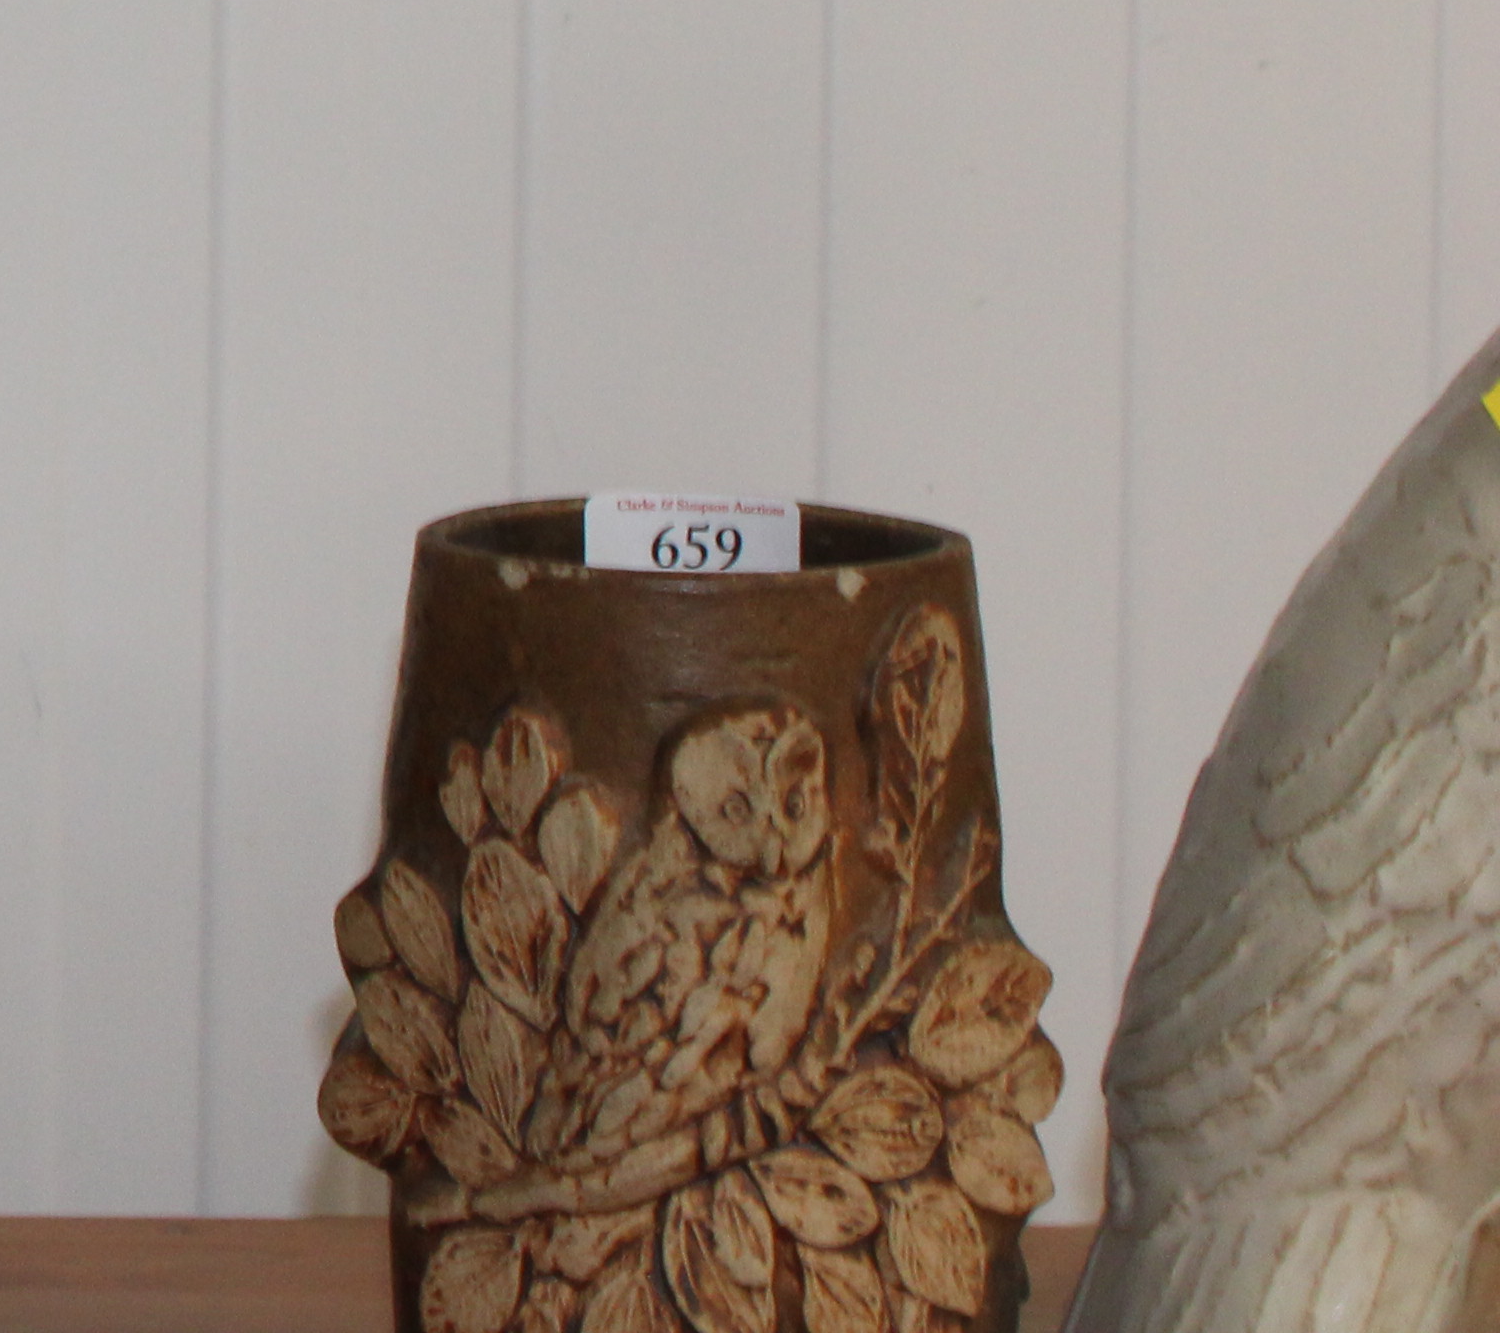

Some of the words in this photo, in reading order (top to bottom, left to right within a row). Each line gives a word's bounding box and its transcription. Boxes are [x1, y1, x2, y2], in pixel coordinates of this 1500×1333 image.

[617, 499, 656, 512] Clarke
[660, 500, 674, 511] &
[676, 500, 730, 515] Simpson
[733, 502, 786, 517] Auctions
[651, 524, 742, 571] 659
